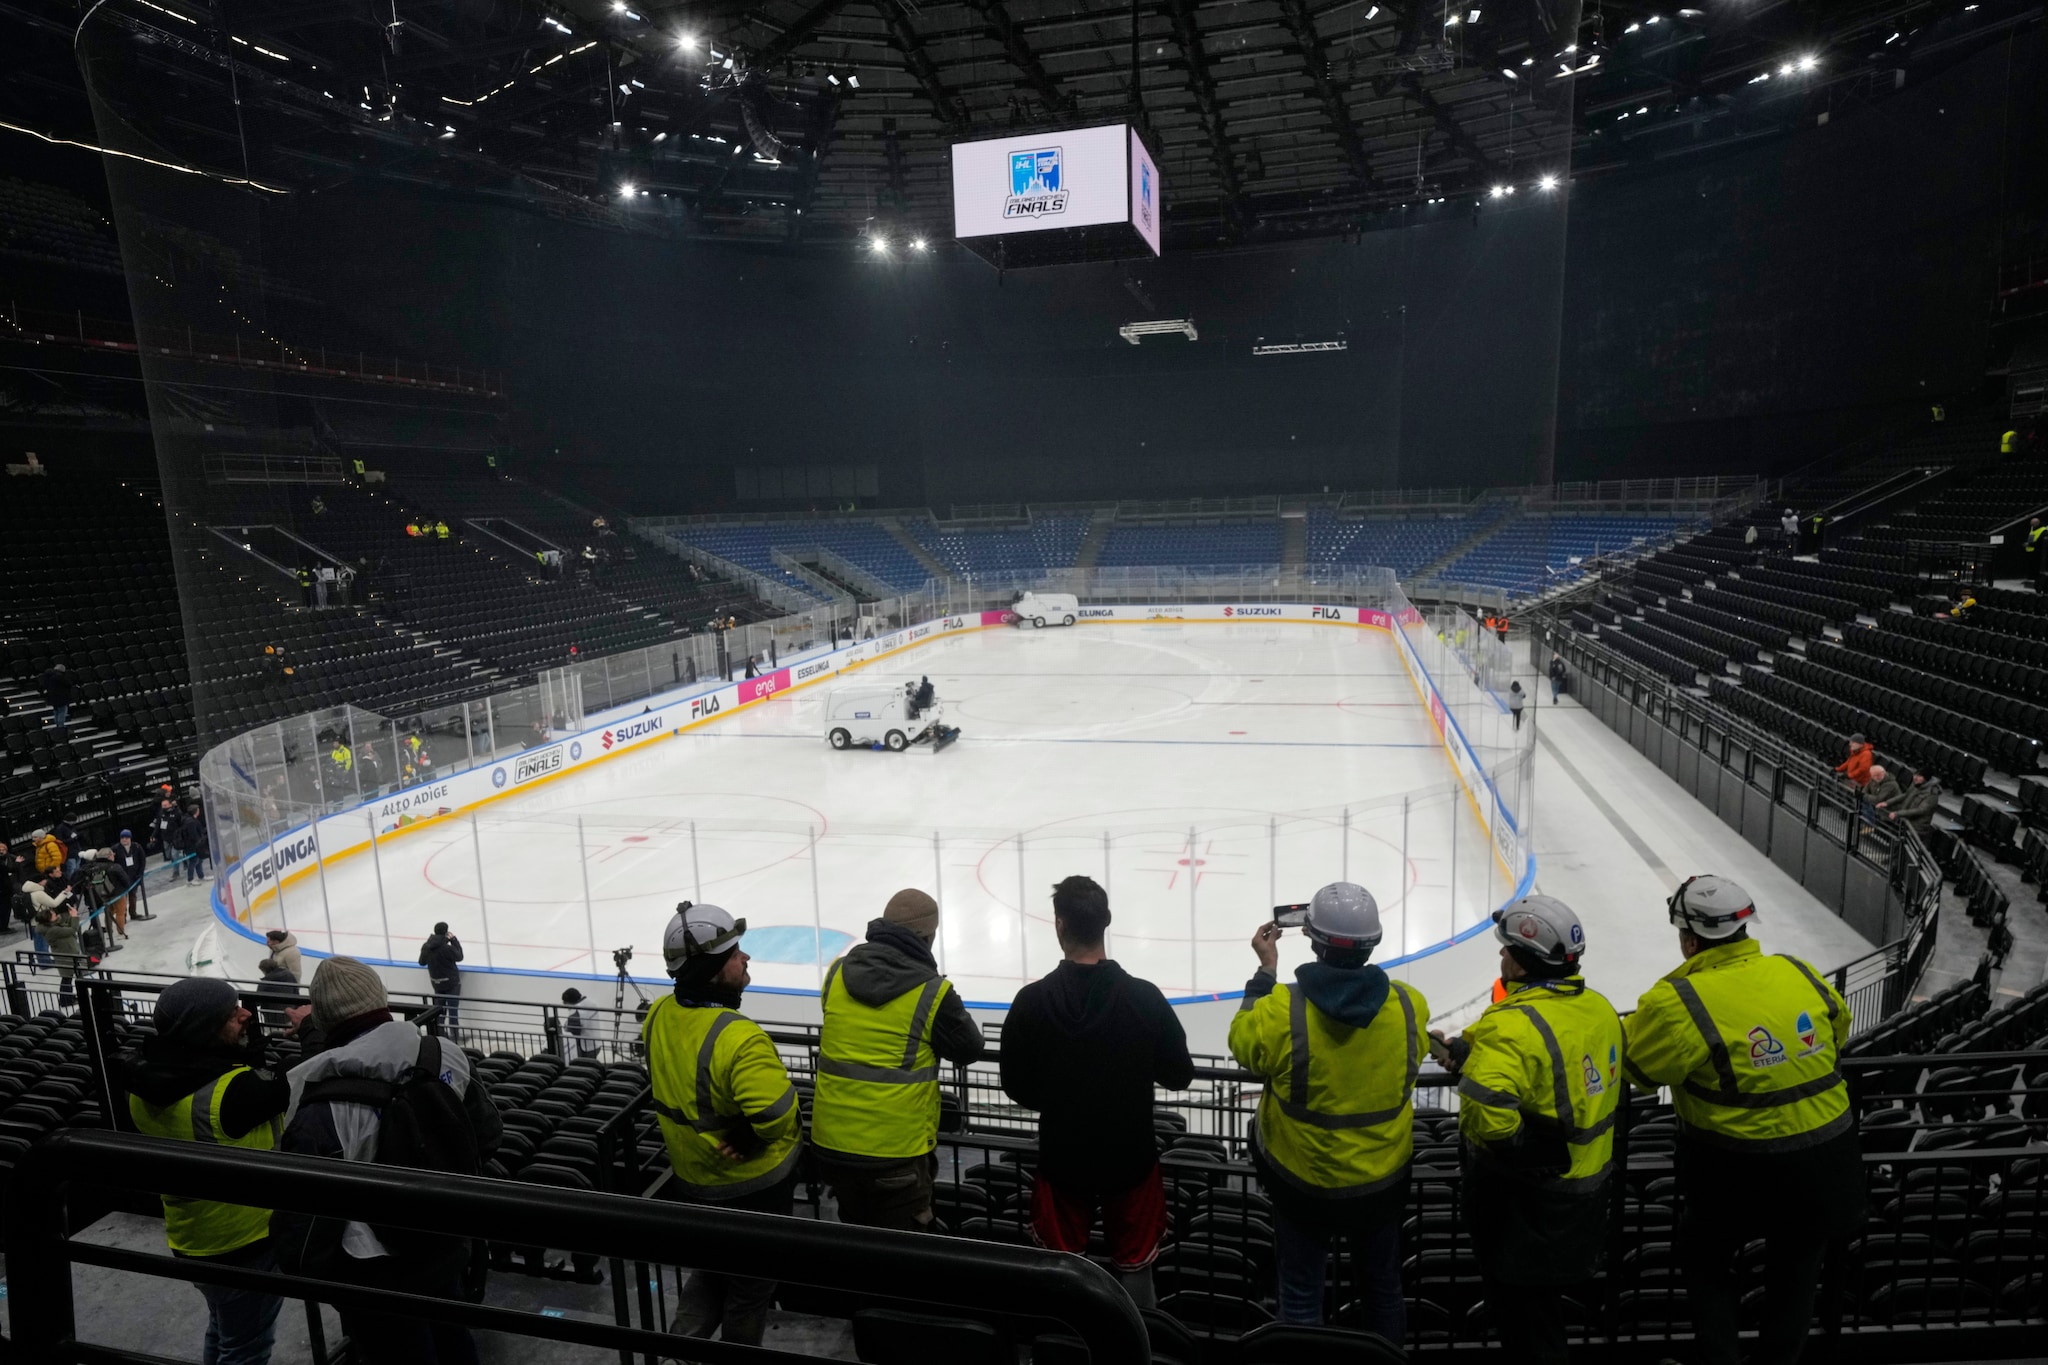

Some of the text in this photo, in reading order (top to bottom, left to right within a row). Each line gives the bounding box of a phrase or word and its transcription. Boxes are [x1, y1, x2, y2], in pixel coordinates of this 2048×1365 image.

[1007, 199, 1064, 215] FINALS
[1078, 609, 1114, 617] ELUNGA
[1236, 607, 1282, 616] SUZUKI
[1312, 607, 1341, 620] FILA
[943, 617, 964, 631] FILA
[797, 660, 830, 680] ESSELUNGA
[755, 676, 776, 697] enel
[691, 695, 720, 720] FILA
[616, 716, 663, 743] SUZUKI
[518, 754, 560, 779] FINALS
[382, 798, 410, 818] ALTO
[1753, 1054, 1788, 1068] ETERIA
[1586, 1084, 1604, 1096] TERIA
